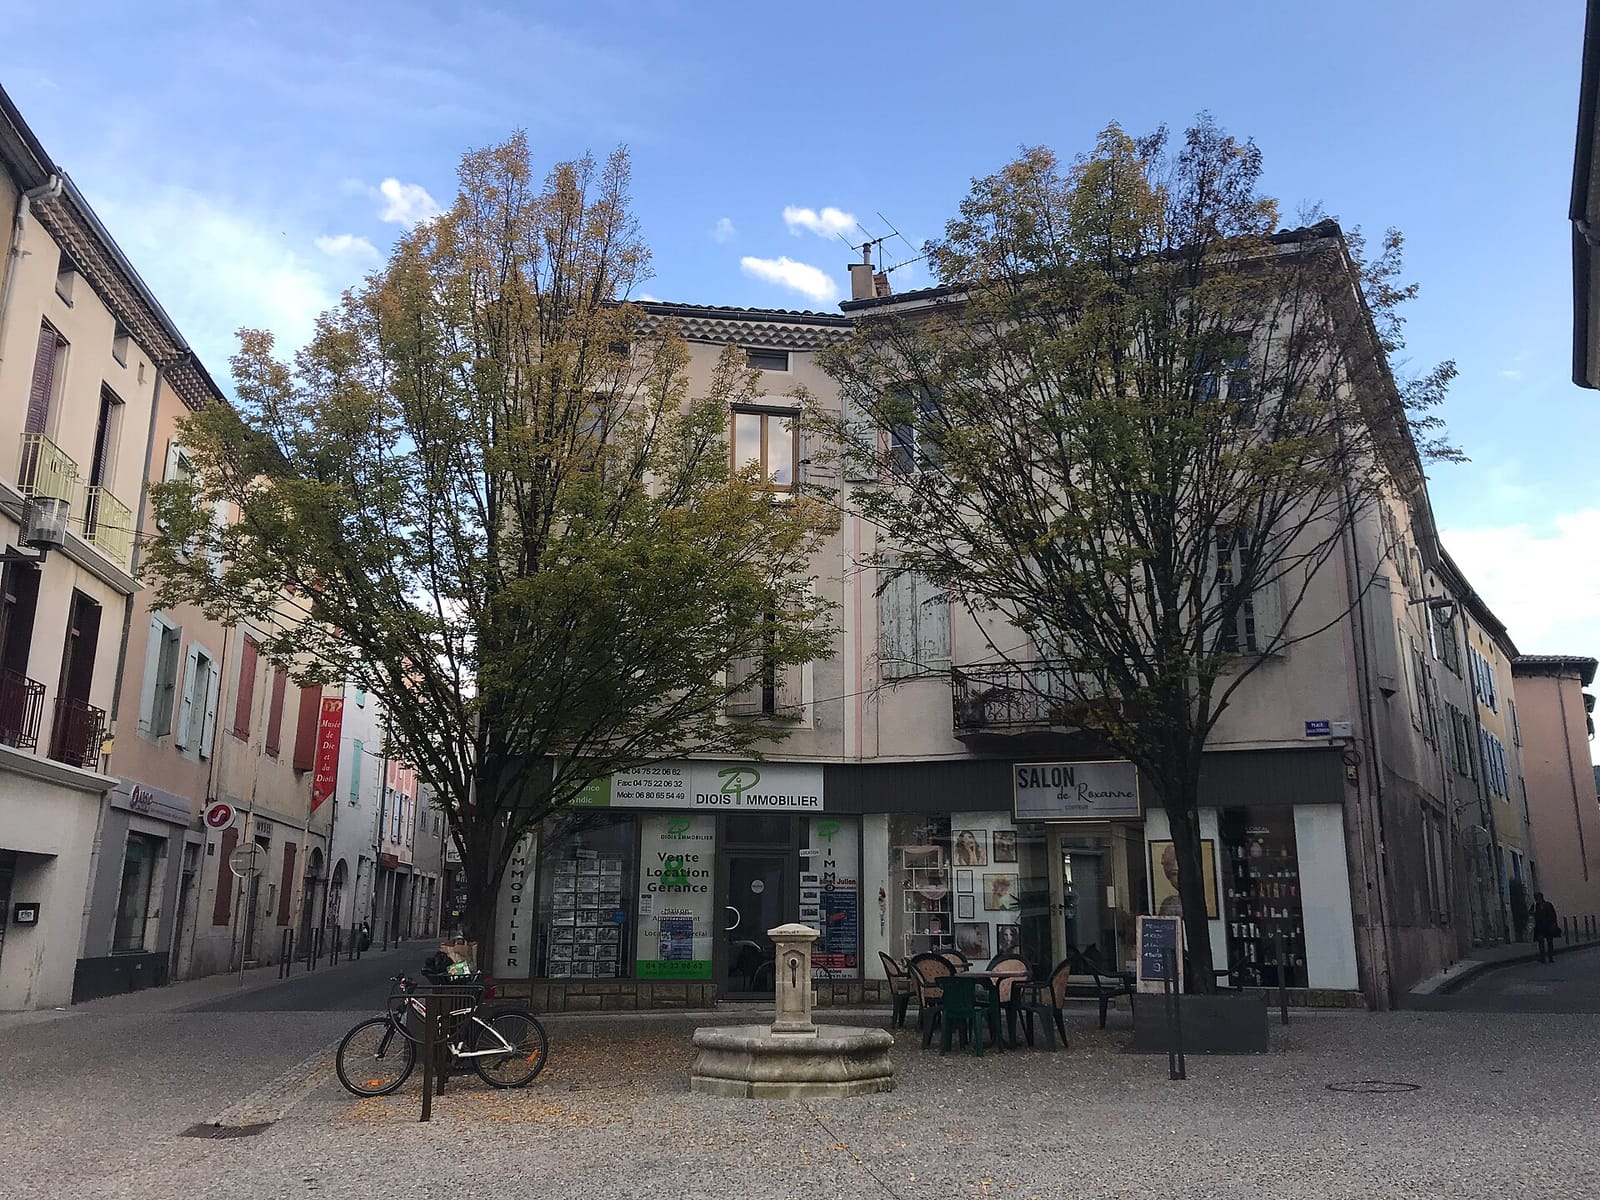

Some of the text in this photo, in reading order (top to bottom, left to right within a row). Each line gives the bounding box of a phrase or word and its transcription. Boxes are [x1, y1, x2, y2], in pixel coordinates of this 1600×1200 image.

[1018, 767, 1075, 788] SALON
[1057, 786, 1072, 800] de
[696, 794, 731, 804] DIOIS
[657, 852, 699, 862] Vente
[646, 867, 709, 878] Location
